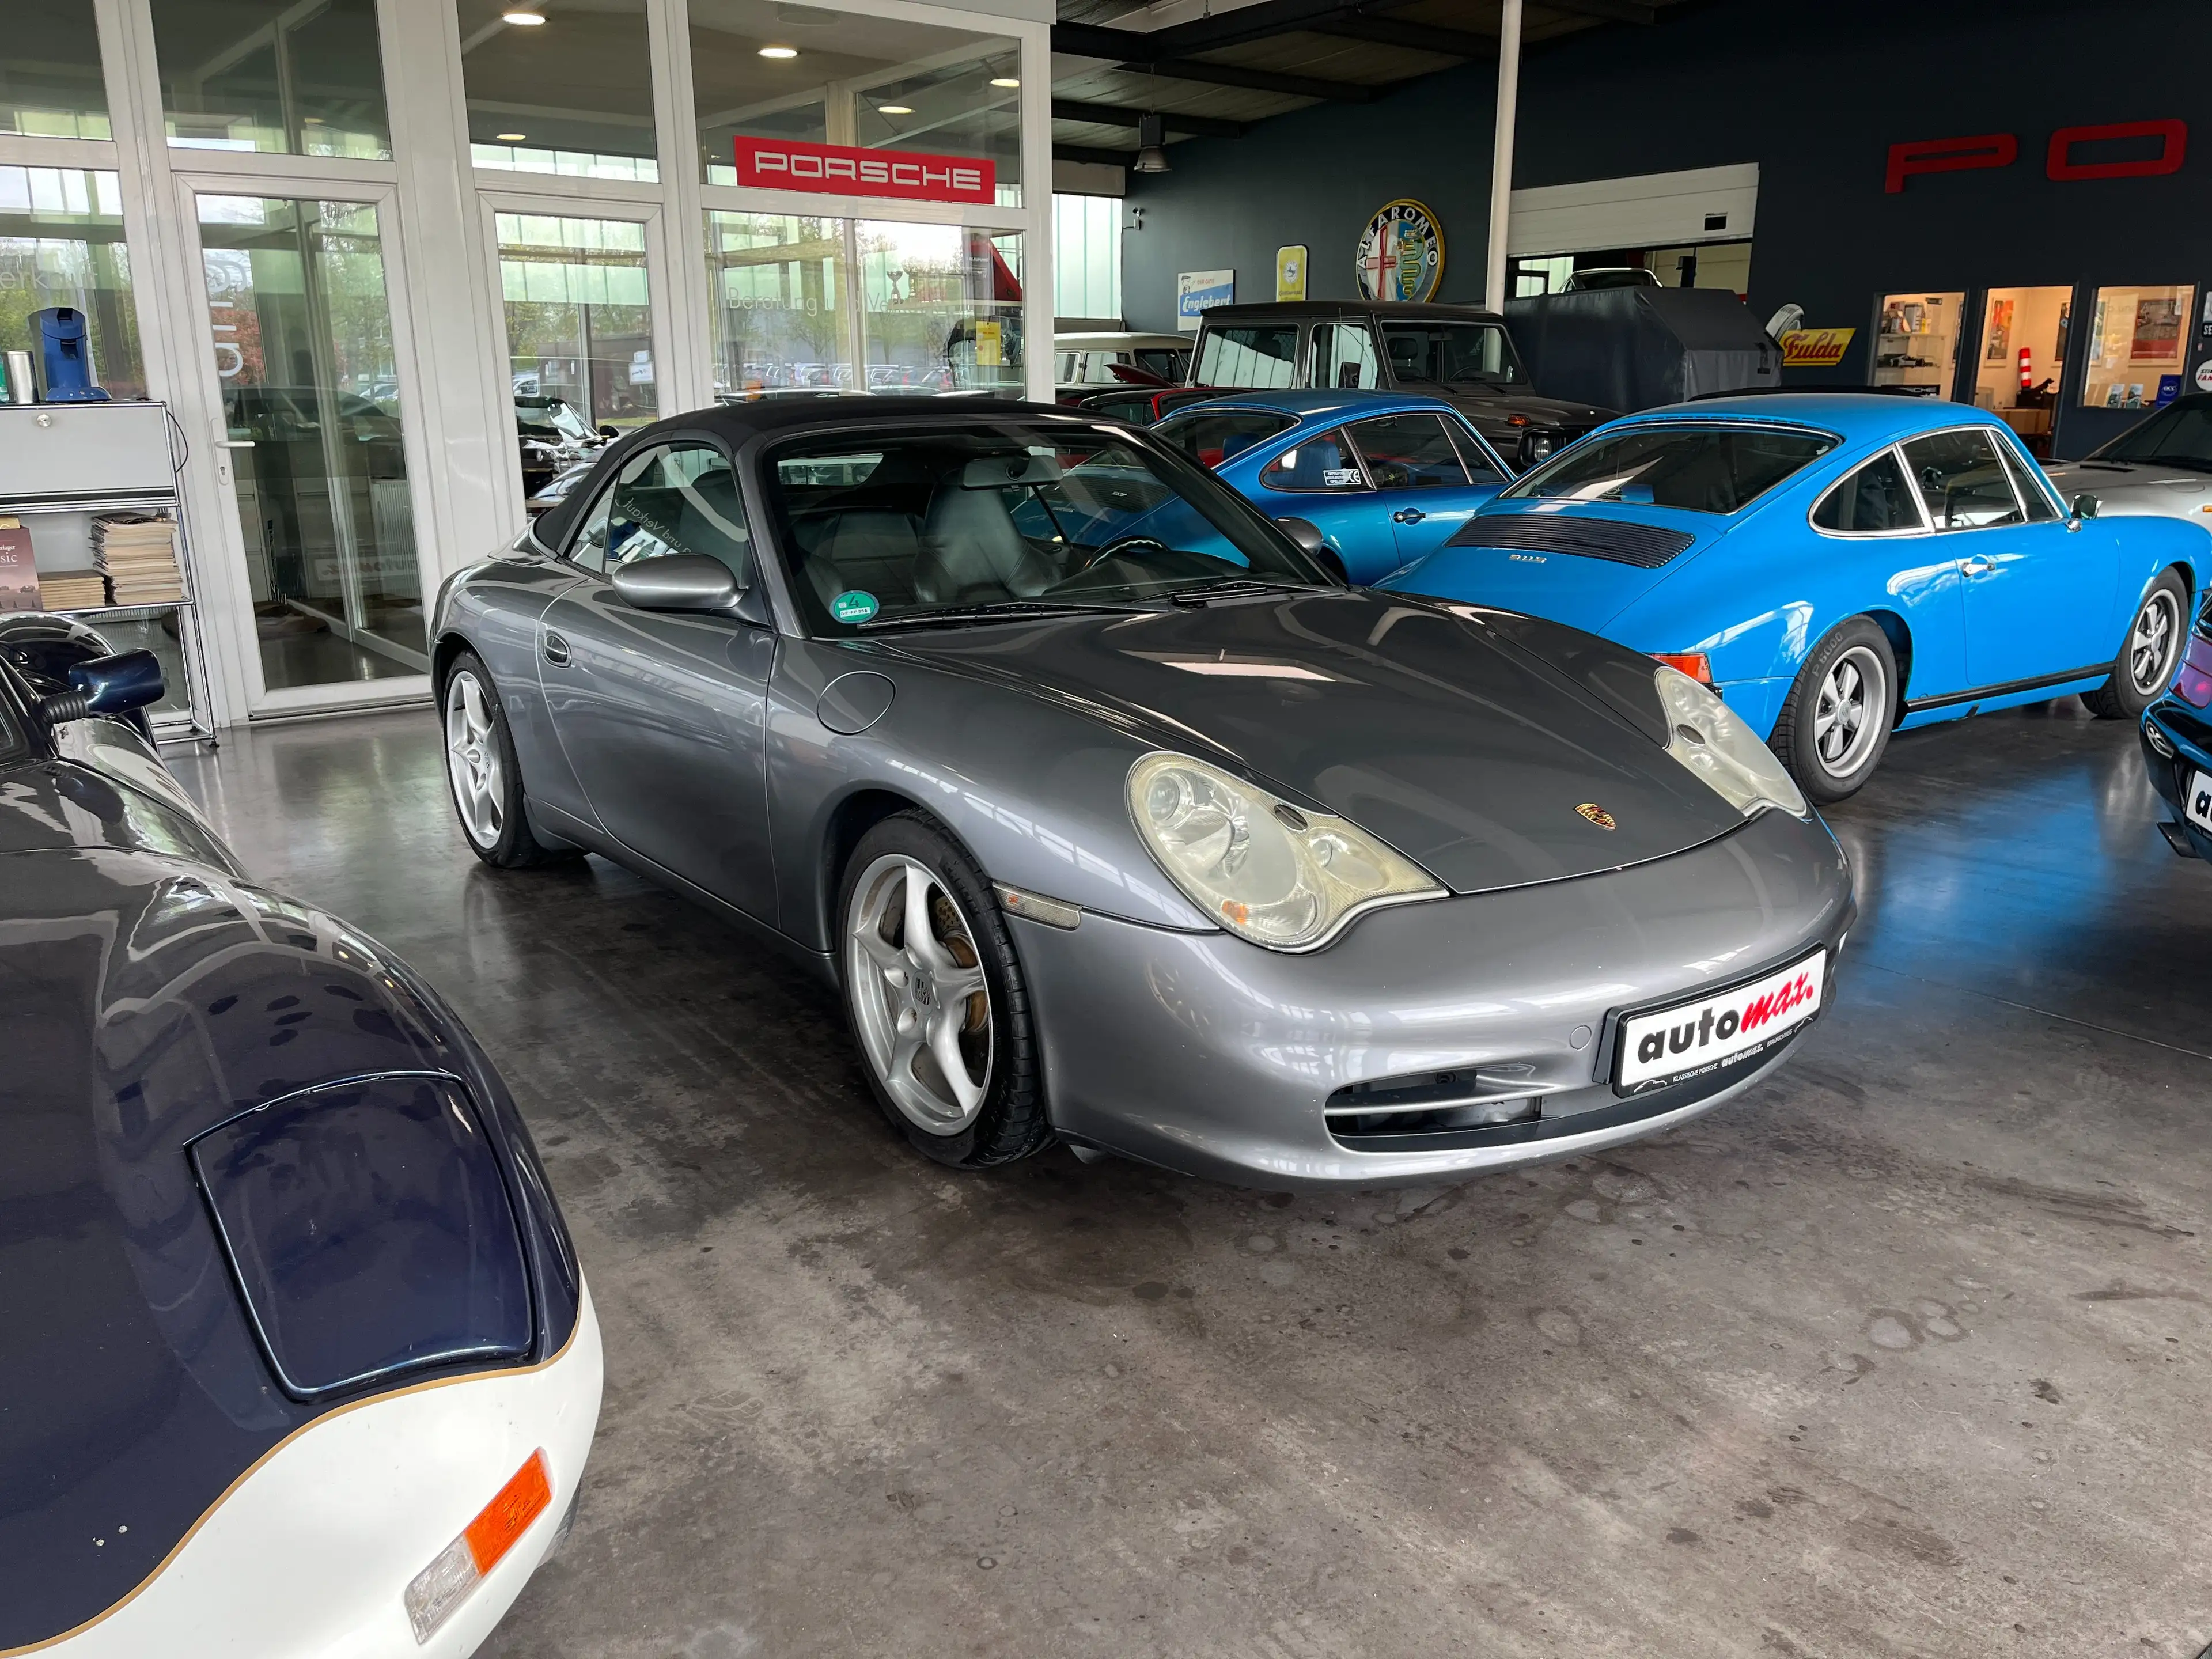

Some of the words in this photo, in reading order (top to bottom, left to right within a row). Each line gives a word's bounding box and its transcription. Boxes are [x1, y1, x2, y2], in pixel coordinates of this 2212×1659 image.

[755, 151, 981, 191] PORSCHE
[1391, 206, 1438, 266] ROMEO
[1182, 294, 1231, 312] Englebert
[1783, 331, 1843, 359] Fulda
[849, 594, 860, 607] 4
[1812, 664, 1820, 676] P
[1672, 1069, 1699, 1082] KLASSISCHE
[1699, 1063, 1718, 1074] PORSCHE
